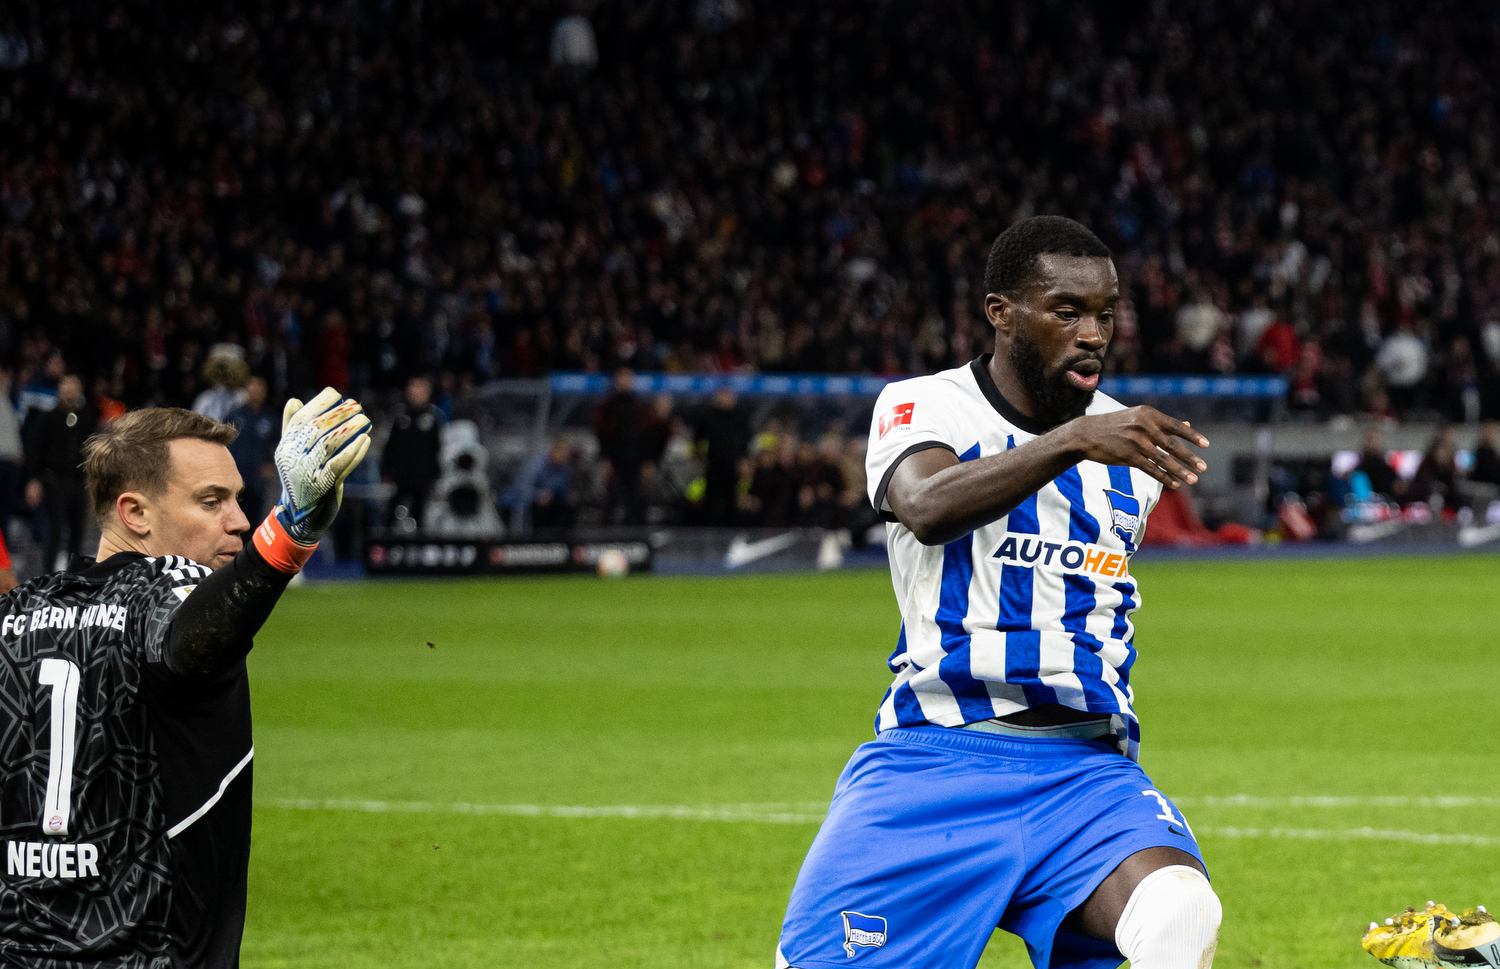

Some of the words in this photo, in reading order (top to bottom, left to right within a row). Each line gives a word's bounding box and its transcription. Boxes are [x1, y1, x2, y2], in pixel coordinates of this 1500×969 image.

[2, 614, 26, 636] FC
[38, 658, 80, 836] 1
[1141, 789, 1197, 844] 1
[7, 840, 100, 879] NEUER
